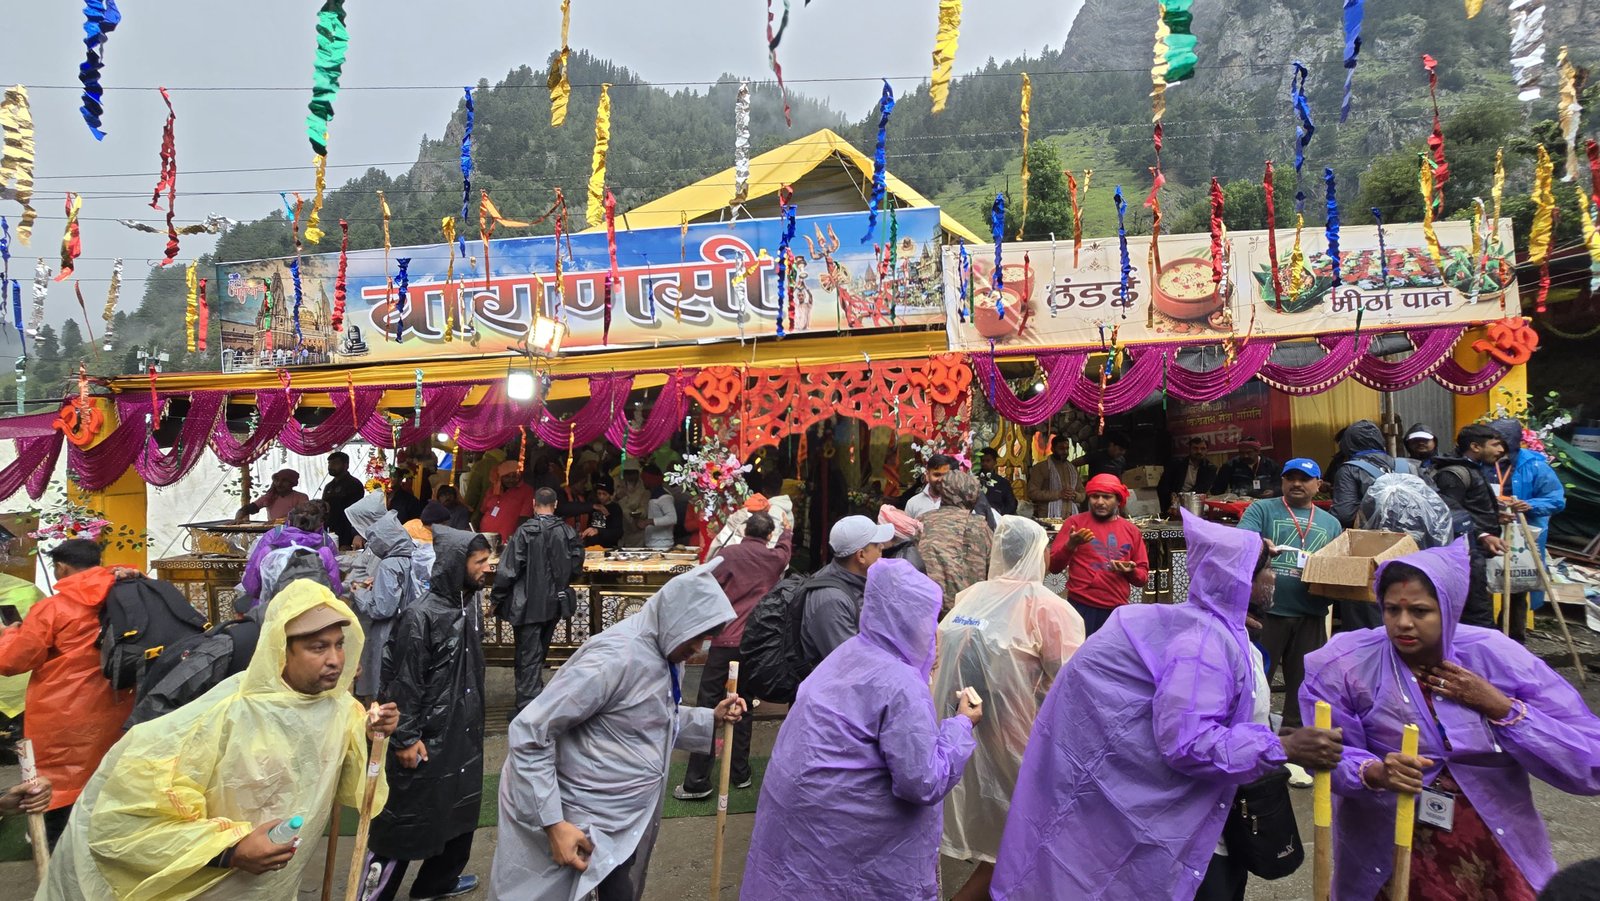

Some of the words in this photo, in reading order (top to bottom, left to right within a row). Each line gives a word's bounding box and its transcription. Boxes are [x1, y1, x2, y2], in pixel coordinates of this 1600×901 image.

[361, 233, 783, 341] वाराणसी
[1046, 266, 1141, 309] ठंडई
[1330, 289, 1393, 312] मीठा
[1400, 290, 1452, 309] पान
